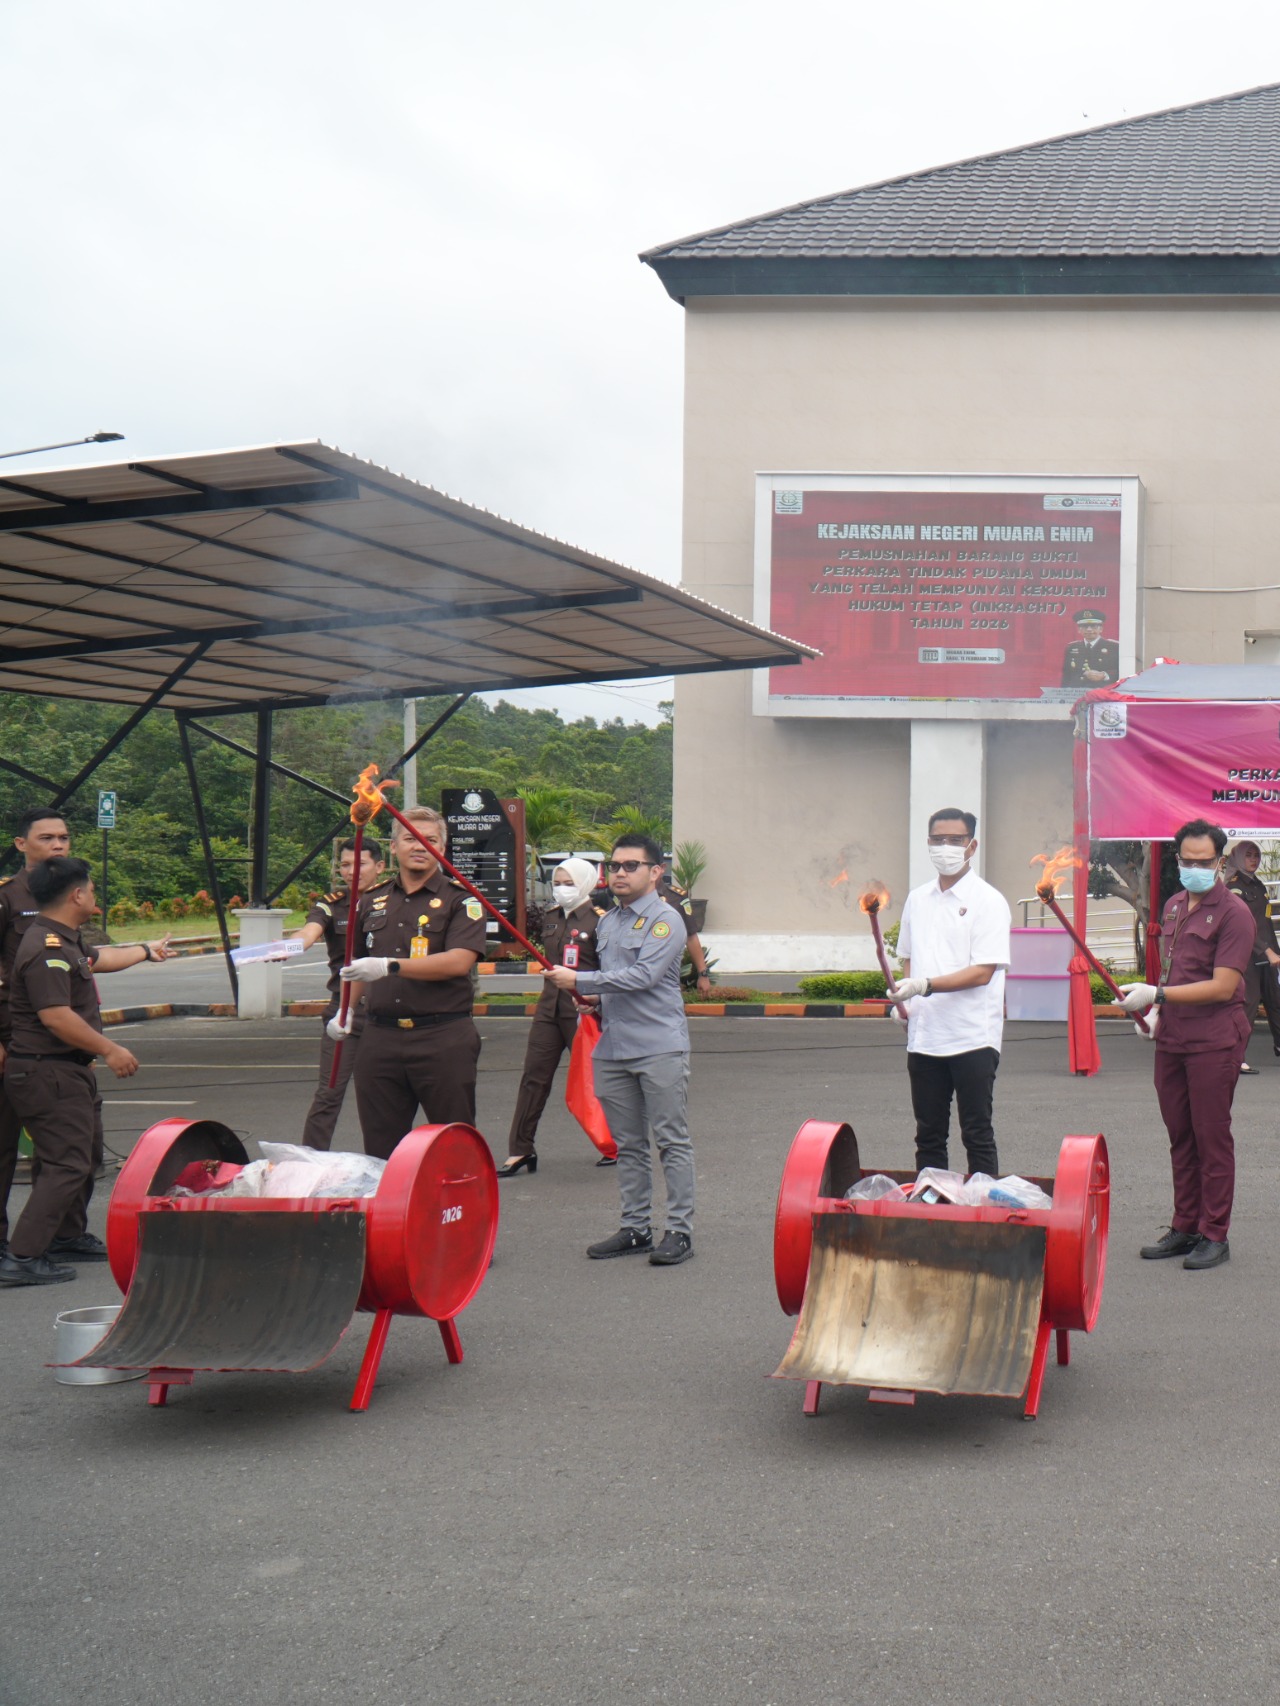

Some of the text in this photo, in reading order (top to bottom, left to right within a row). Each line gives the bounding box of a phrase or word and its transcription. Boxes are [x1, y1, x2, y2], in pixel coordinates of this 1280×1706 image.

[818, 523, 1094, 542] KEJAKSAAN NEGERI MUARA ENIM
[838, 548, 1079, 562] PEMUSNAHAN BARANG BUKTI
[823, 565, 1087, 580] PERKARA TINDAK PIDANA UMUM
[808, 582, 1107, 597] YANG TELAH MEMPUNYAI KEKUATAN
[848, 600, 1067, 616] HUKUM TETAP (INKRACHT)
[910, 617, 1010, 630] TAHUN 2026
[447, 814, 501, 823] KEJAKSAAN NEGERI
[457, 823, 491, 831] MUARA ENIM
[442, 1205, 463, 1225] 2026
